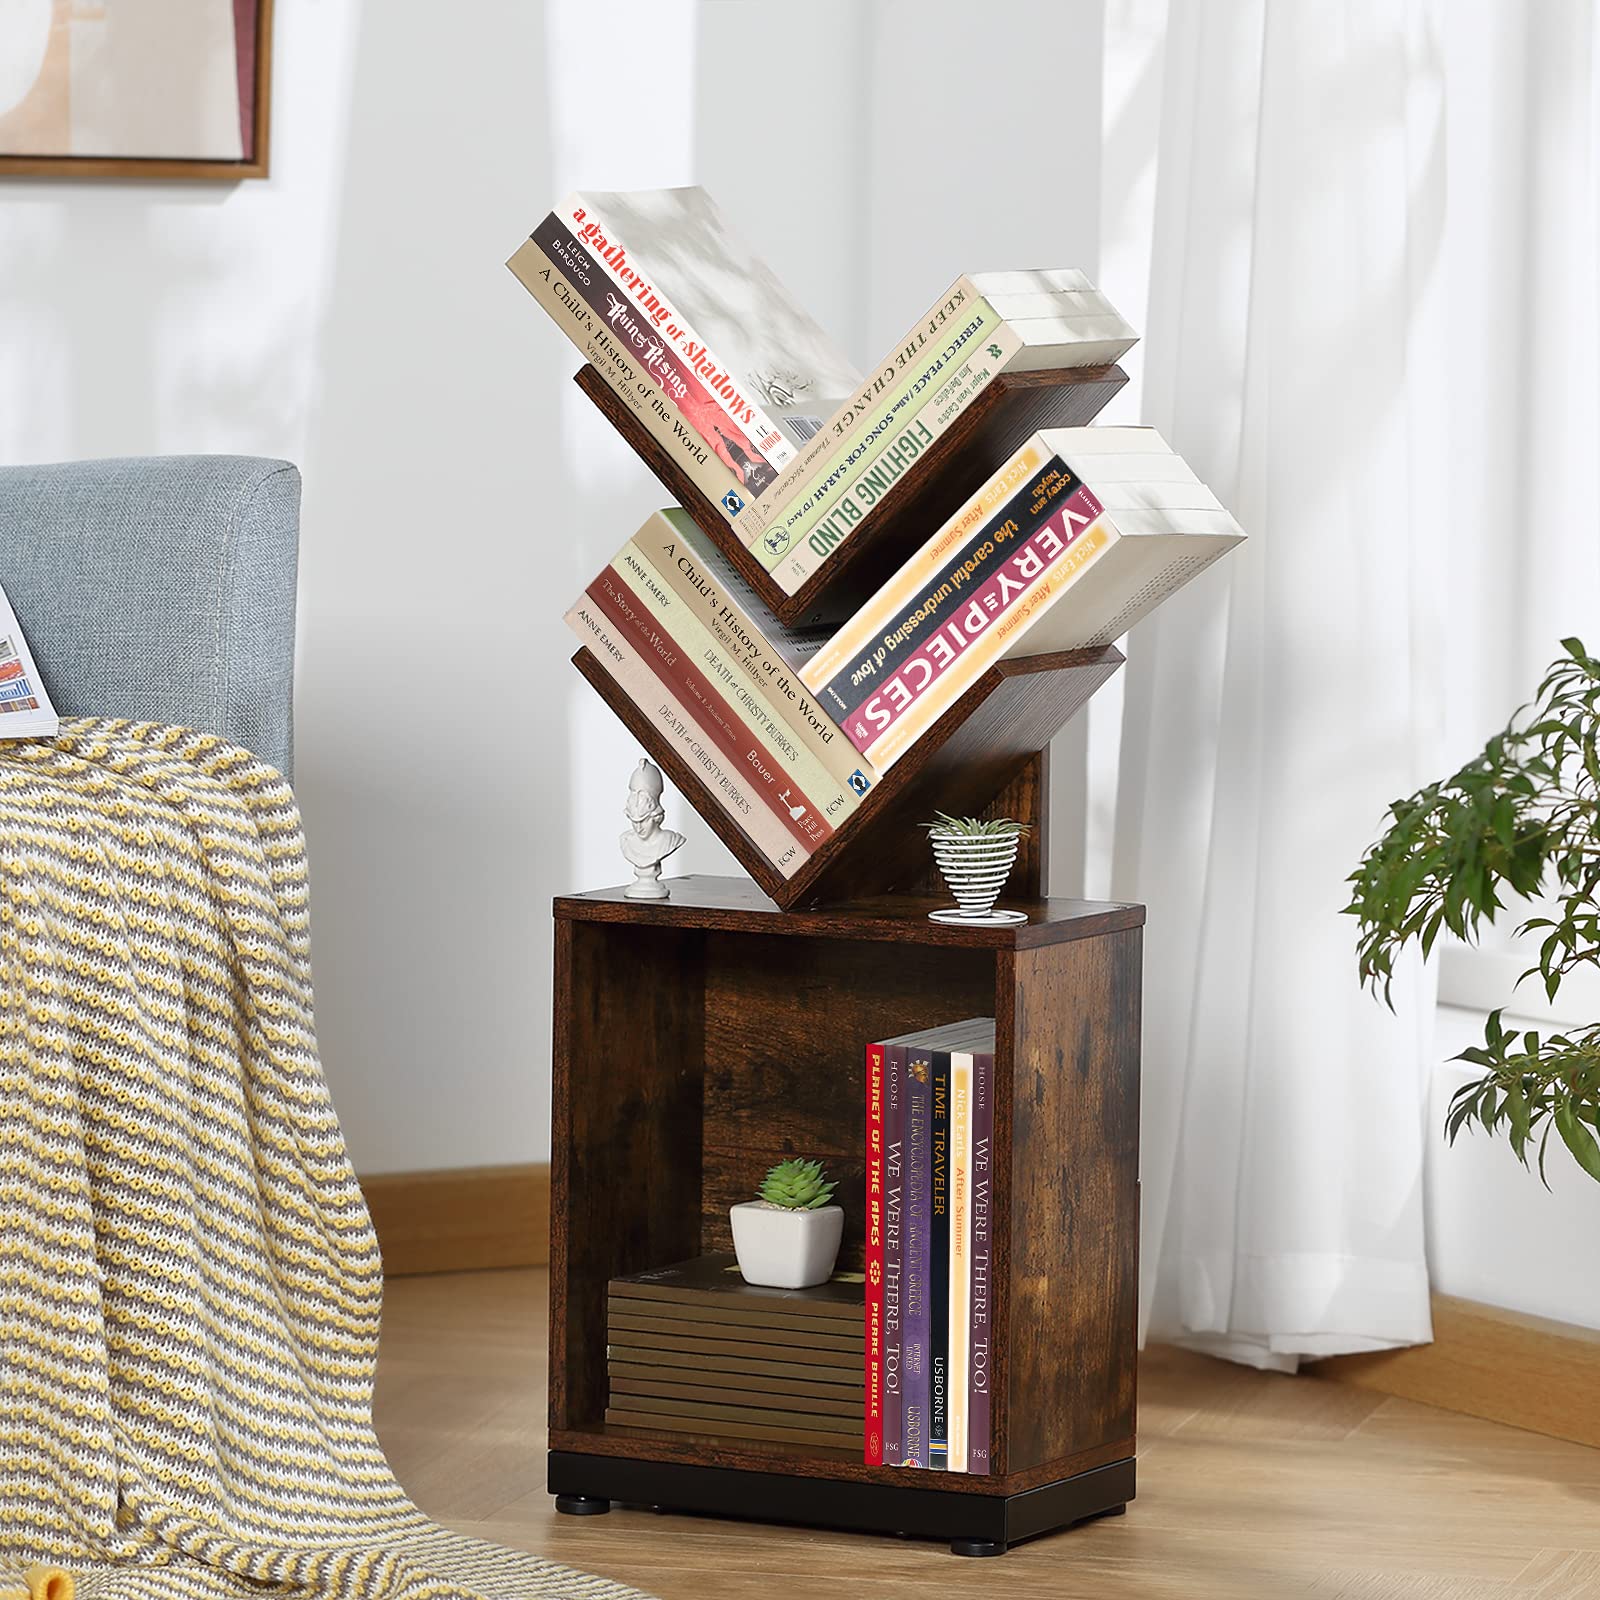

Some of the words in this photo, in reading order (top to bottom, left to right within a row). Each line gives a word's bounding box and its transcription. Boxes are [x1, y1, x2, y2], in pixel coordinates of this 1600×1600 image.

[572, 207, 586, 225] a
[551, 240, 591, 287] BARDUGO
[566, 241, 591, 271] LEIGH
[576, 220, 672, 328] gathering
[929, 289, 965, 334] KEEP
[665, 323, 686, 342] of
[896, 332, 927, 369] THE
[942, 315, 984, 362] PERFECT
[538, 268, 551, 283] A
[552, 280, 595, 332] Child's
[593, 328, 638, 382] History
[636, 382, 655, 399] of
[651, 398, 671, 423] the
[671, 419, 709, 466] World
[585, 341, 607, 368] Virgil
[604, 366, 616, 381] M.
[616, 379, 643, 411] Hillyer
[642, 335, 688, 409] Rising
[680, 340, 757, 425] shadows
[912, 359, 944, 394] PEACE
[958, 363, 973, 379] Jim
[969, 367, 991, 390] Major
[832, 367, 895, 438] CHANGE
[937, 401, 960, 424] Castro
[956, 387, 973, 404] Ivan
[865, 412, 895, 444] SONG
[847, 441, 868, 467] FOR
[855, 420, 934, 506] FIGHTING
[1007, 460, 1028, 482] Nick
[813, 465, 847, 501] SARAH
[985, 480, 1008, 504] Earls
[1031, 470, 1061, 498] haydu
[1046, 473, 1071, 500] corey
[961, 503, 984, 528] After
[1029, 497, 1048, 516] ann
[808, 497, 863, 557] BLIND
[930, 525, 963, 561] Summer
[994, 519, 1019, 543] the
[949, 541, 995, 590] careful
[996, 508, 1090, 606] VERY
[1074, 539, 1096, 562] Nick
[624, 555, 648, 580] ANNE
[645, 579, 671, 607] EMERY
[1053, 560, 1077, 583] Earls
[1030, 582, 1051, 607] After
[602, 578, 616, 597] The
[614, 592, 637, 621] Story
[649, 632, 677, 667] World
[883, 582, 953, 652] undressing
[997, 603, 1032, 640] Summer
[577, 610, 602, 636] ANNE
[599, 633, 626, 662] EMERY
[662, 544, 676, 558] A
[677, 556, 719, 608] Child's
[718, 605, 764, 660] History
[762, 659, 780, 678] of
[776, 676, 797, 702] the
[796, 698, 835, 745] World
[710, 618, 732, 647] Virgil
[730, 645, 743, 660] M.
[742, 657, 769, 689] Hillyer
[850, 659, 877, 687] love
[864, 599, 990, 731] PIECES
[872, 647, 887, 667] of
[703, 649, 735, 684] DEATH
[736, 688, 769, 729] CHRISTY
[826, 687, 848, 711] DUTTON
[658, 704, 690, 739] DEATH
[690, 742, 723, 781] CHRISTY
[747, 749, 776, 785] Bauer
[826, 794, 846, 816] ECW
[805, 821, 817, 834] Hill
[778, 846, 797, 867] ECW
[871, 1054, 881, 1124] PLANET
[890, 1061, 898, 1110] HOOSE
[934, 1073, 946, 1119] TIME
[956, 1089, 965, 1119] Nick
[911, 1094, 925, 1116] THE
[871, 1130, 880, 1155] OF
[887, 1141, 902, 1177] WE
[909, 1117, 925, 1202] ENCYCLOPEDIA
[956, 1125, 965, 1158] Earls
[975, 1136, 989, 1173] WE
[870, 1158, 880, 1194] THE
[934, 1130, 946, 1216] TRAVELER
[956, 1167, 965, 1201] After
[870, 1201, 880, 1247] APES
[887, 1186, 901, 1250] WERE
[909, 1202, 923, 1220] OF
[975, 1178, 989, 1243] WERE
[909, 1221, 923, 1270] ANCIENT
[955, 1206, 964, 1257] Summer
[886, 1258, 901, 1335] THERE,
[908, 1273, 922, 1316] GREECE
[974, 1249, 989, 1329] THERE,
[871, 1302, 879, 1356] PIERRE
[886, 1343, 900, 1395] TOO!
[912, 1343, 921, 1374] INTERNET
[974, 1337, 988, 1394] TOO!
[871, 1362, 879, 1417] BOULLE
[934, 1357, 944, 1423] USBORNE
[885, 1442, 899, 1452] FSG
[907, 1406, 921, 1457] USBORNE
[972, 1449, 987, 1459] FSG
